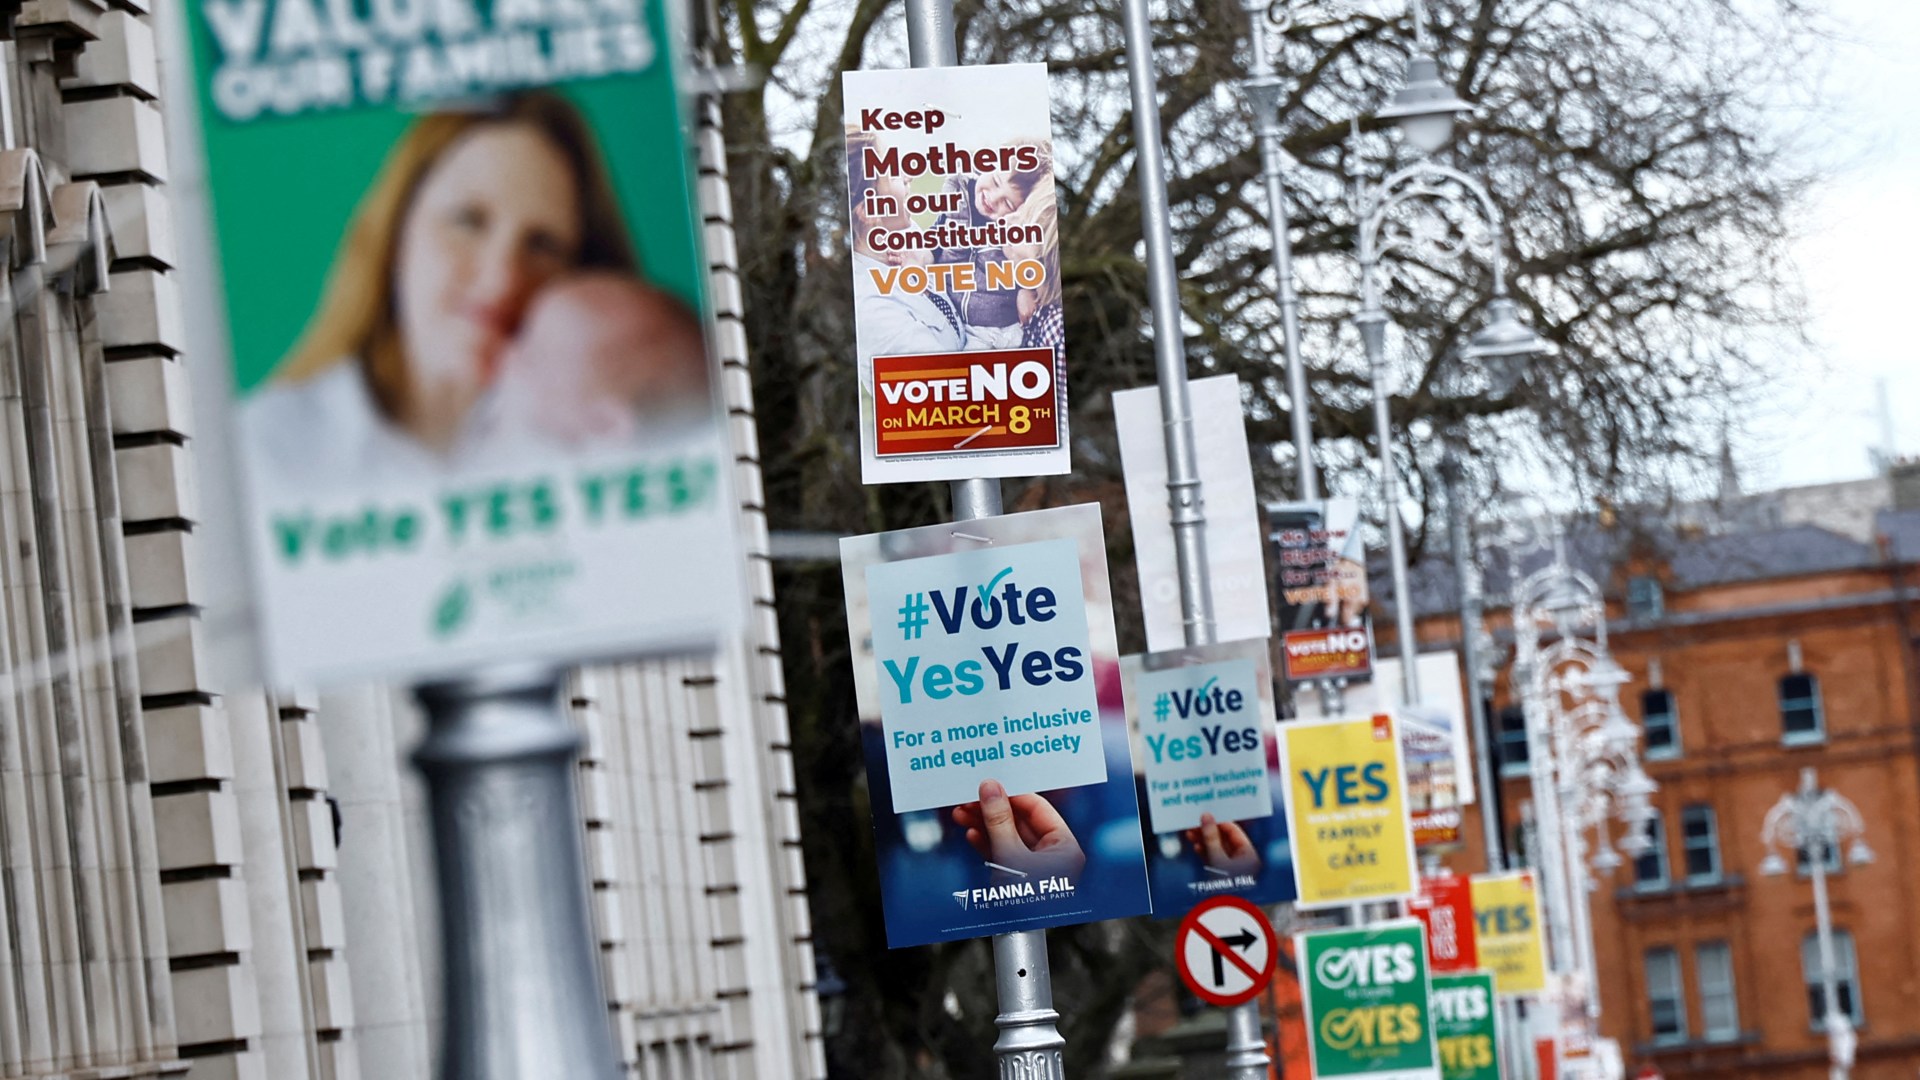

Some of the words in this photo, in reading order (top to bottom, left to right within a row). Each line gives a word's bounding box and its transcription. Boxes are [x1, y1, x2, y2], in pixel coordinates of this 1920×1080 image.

[861, 108, 945, 134] Keep
[864, 142, 1038, 179] Mothers
[866, 190, 897, 216] in
[906, 192, 962, 214] our
[868, 219, 1043, 251] Constitution
[870, 264, 976, 295] VOTE
[987, 261, 1045, 289] NO
[880, 378, 968, 405] VOTE
[970, 360, 1051, 401] NO
[882, 418, 903, 429] ON
[907, 404, 1000, 427] MARCH
[272, 504, 421, 564] Vote
[441, 476, 558, 537] YES
[898, 582, 1057, 641] #Vote
[1327, 631, 1367, 652] NO
[1153, 686, 1243, 722] #Vote
[893, 730, 925, 749] For
[931, 729, 943, 744] a
[948, 718, 998, 742] more
[1003, 708, 1092, 733] inclusive
[910, 750, 945, 771] and
[950, 741, 1004, 768] equal
[1010, 733, 1081, 759] society
[1151, 778, 1170, 793] For
[1172, 778, 1180, 789] a
[1182, 773, 1211, 789] more
[1212, 766, 1262, 784] inclusive
[1161, 791, 1182, 807] and
[1184, 787, 1215, 806] equal
[1217, 783, 1258, 802] society
[1301, 761, 1390, 809] YES
[1317, 823, 1383, 841] FAMILY
[1327, 851, 1379, 870] CARE
[972, 882, 1034, 903] FIANNA
[1039, 875, 1075, 894] FÁIL
[994, 895, 1046, 907] REPUBLICAN
[1050, 891, 1075, 900] PARTY
[1475, 904, 1532, 935] YES
[1350, 942, 1417, 987] YES
[1434, 985, 1489, 1022] YES
[1356, 1003, 1422, 1046] YES
[1440, 1034, 1493, 1069] YES
